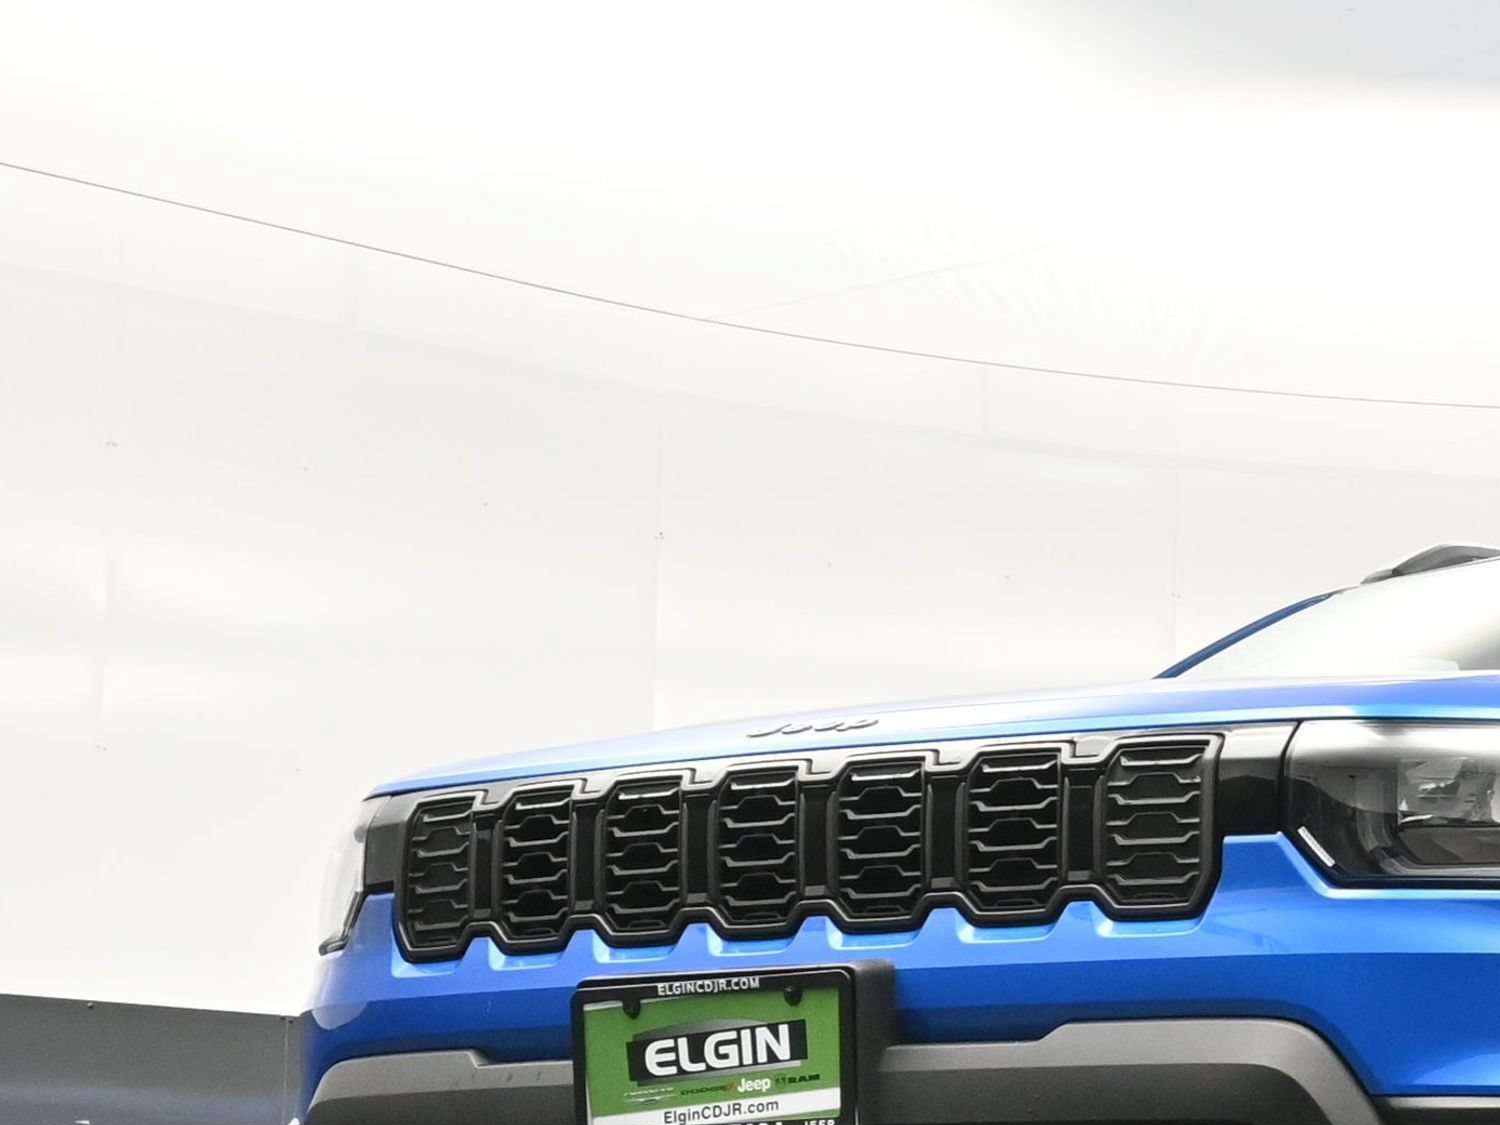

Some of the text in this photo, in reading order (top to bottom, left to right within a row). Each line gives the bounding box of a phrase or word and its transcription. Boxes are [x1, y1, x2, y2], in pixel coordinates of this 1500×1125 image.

[658, 977, 760, 996] ELGINCDJR.COM
[644, 1023, 791, 1077] ELGIN
[737, 1077, 770, 1093] Jeep
[788, 1073, 820, 1084] RAM
[663, 1099, 779, 1125] ElginCDJR.com
